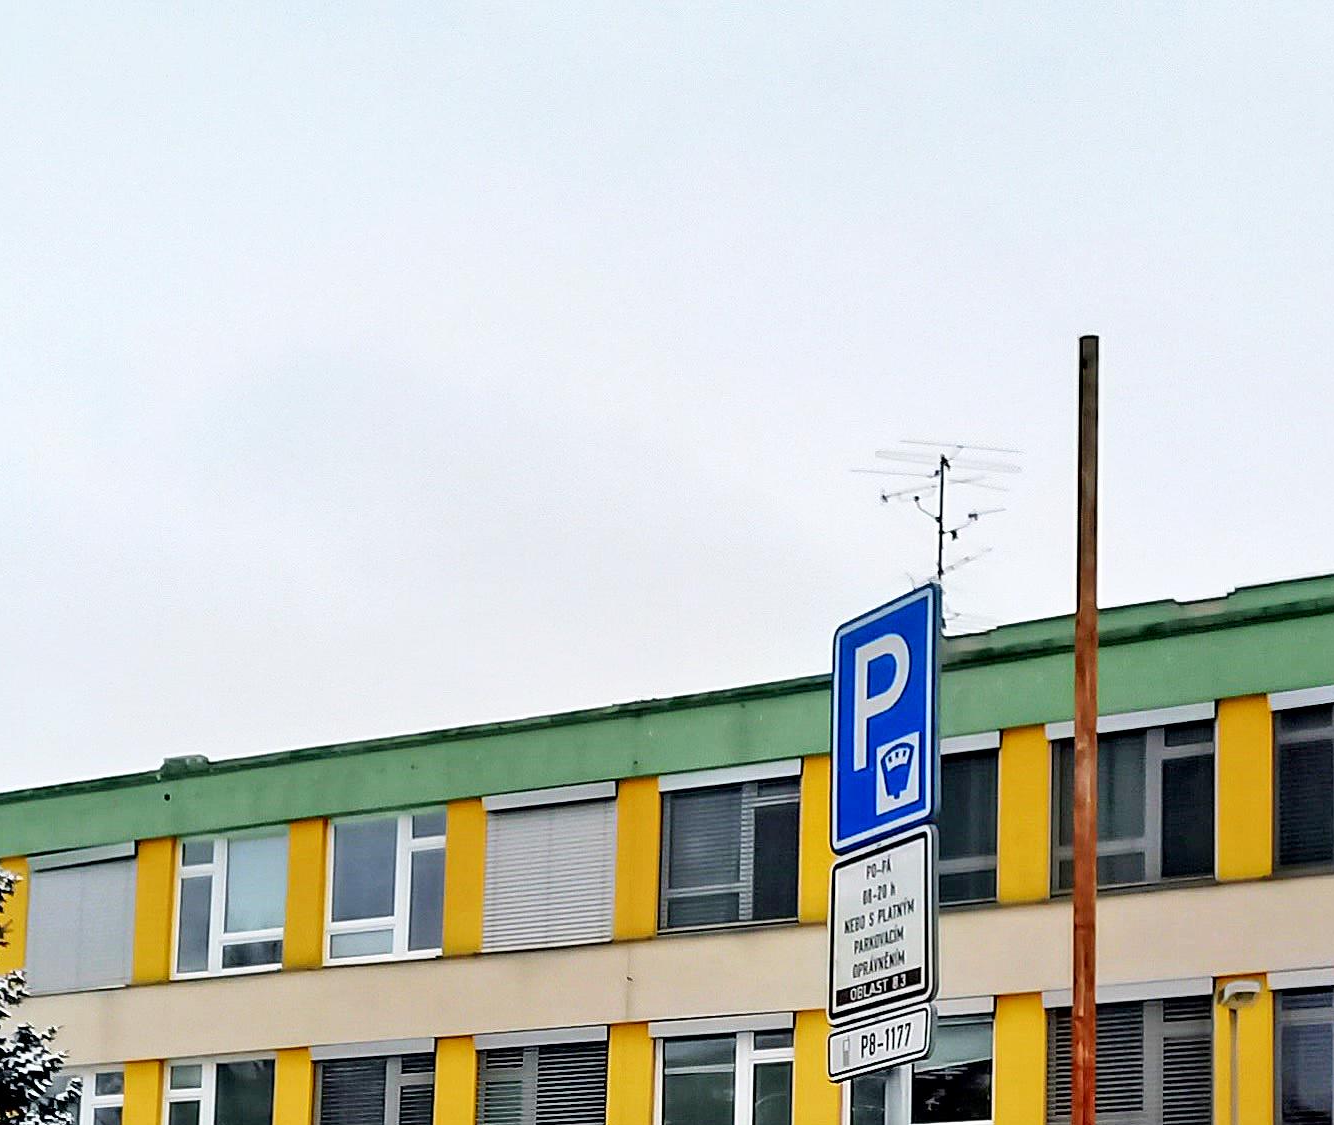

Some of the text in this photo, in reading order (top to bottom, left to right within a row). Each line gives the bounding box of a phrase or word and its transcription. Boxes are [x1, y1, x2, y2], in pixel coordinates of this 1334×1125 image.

[853, 632, 911, 772] P
[844, 915, 866, 934] NEBO
[869, 912, 875, 927] S
[850, 979, 889, 1001] OBLAST
[861, 1022, 912, 1058] P8-1177
